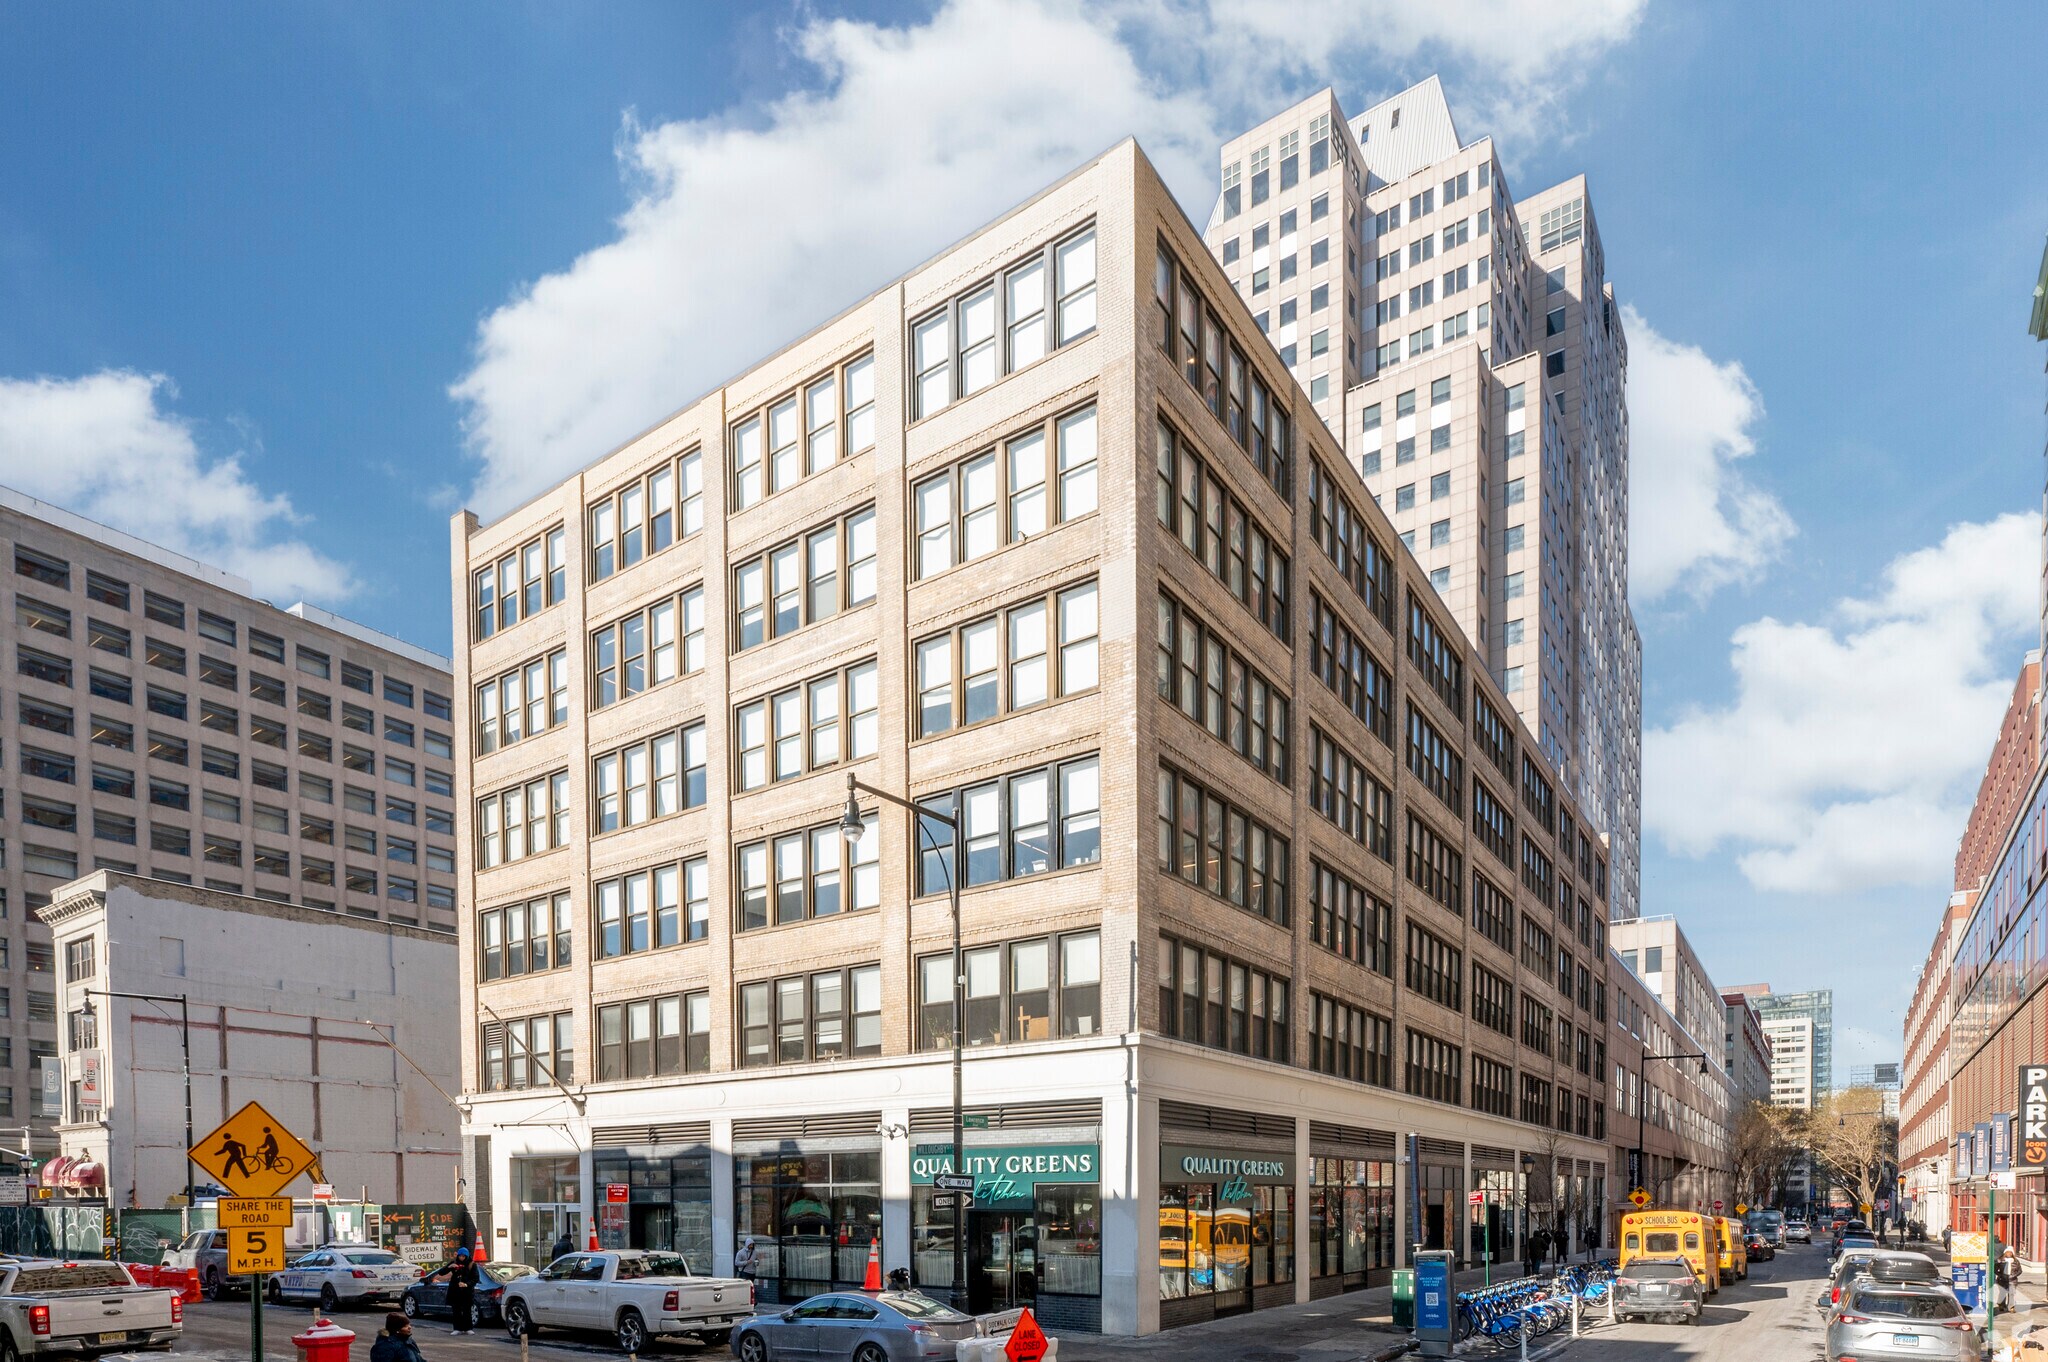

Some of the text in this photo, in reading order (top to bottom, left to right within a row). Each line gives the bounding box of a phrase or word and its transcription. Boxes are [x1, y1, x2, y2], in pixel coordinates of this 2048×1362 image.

[2025, 1068, 2048, 1139] PARK
[1995, 1154, 2003, 1164] THE
[913, 1155, 1093, 1178] QUAITY GREENS
[1182, 1156, 1285, 1177] QUALITY GREENS
[226, 1201, 260, 1212] SHARE
[265, 1201, 284, 1211] THE
[241, 1213, 270, 1223] ROAD
[430, 1214, 453, 1224] SIDE
[1645, 1216, 1678, 1224] SCHOOL BUS
[443, 1228, 464, 1236] CLOSE
[246, 1231, 267, 1254] 5
[404, 1245, 439, 1253] SIDEWALK
[237, 1257, 277, 1268] M.P.H.
[988, 1319, 1007, 1329] SIDEWALK
[1018, 1329, 1037, 1340] LANE
[1014, 1341, 1041, 1352] CLOSED
